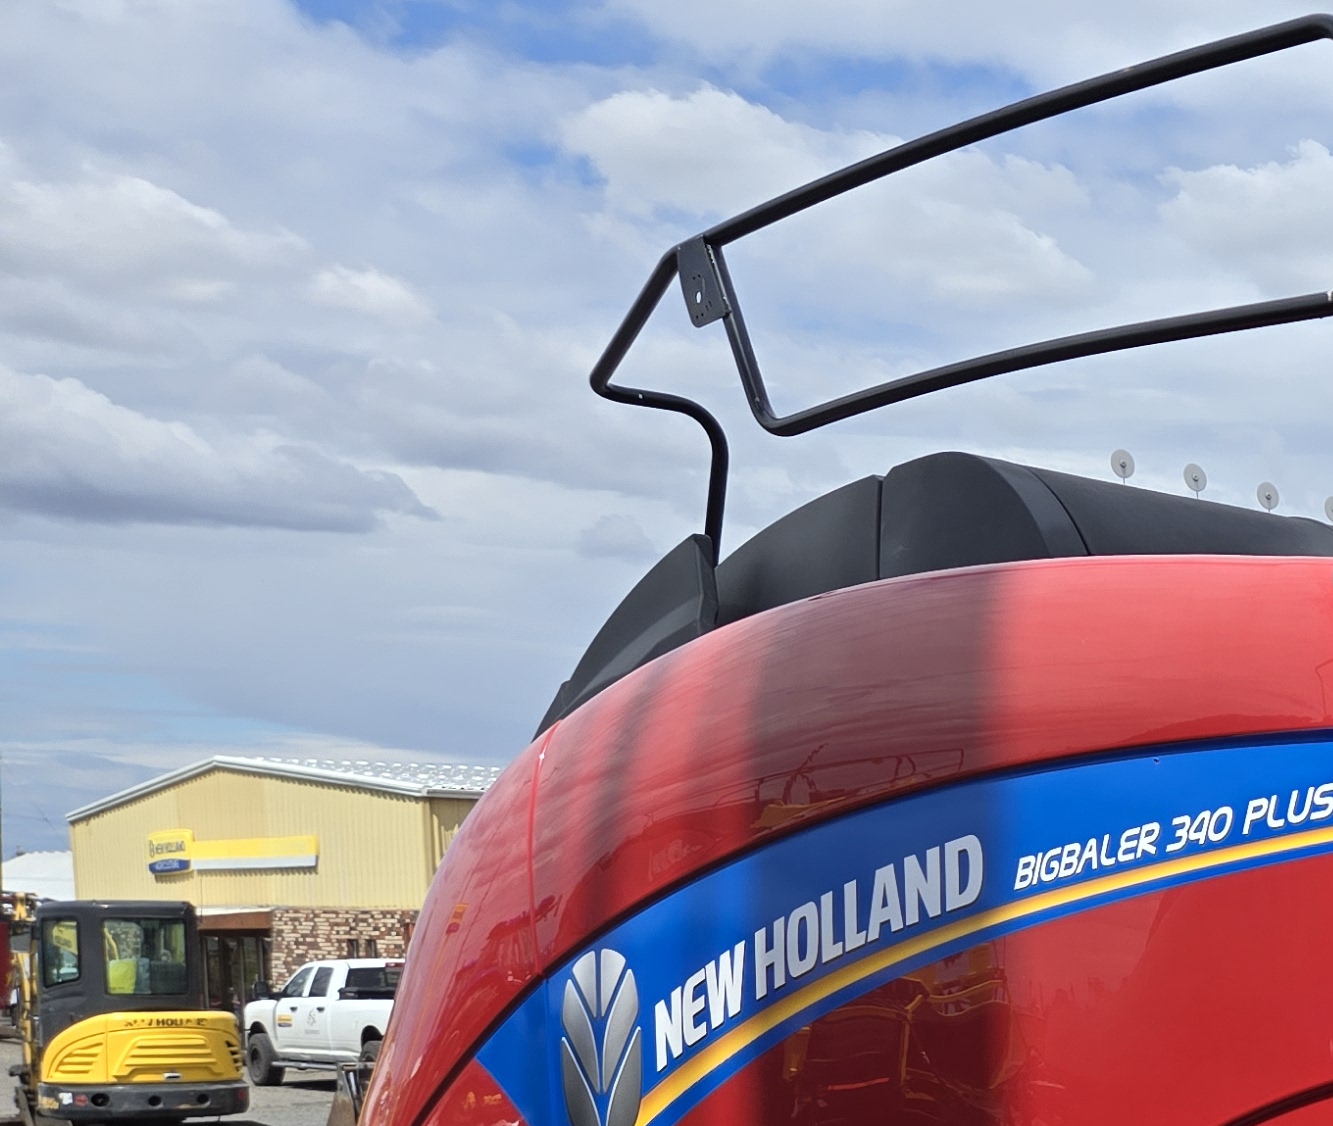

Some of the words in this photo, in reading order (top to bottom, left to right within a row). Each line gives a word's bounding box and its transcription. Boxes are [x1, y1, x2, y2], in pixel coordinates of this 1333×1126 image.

[1013, 821, 1160, 890] BIGBALER
[1165, 806, 1234, 853] 340
[654, 939, 746, 1073] NEW
[754, 834, 984, 1001] HOLLAND
